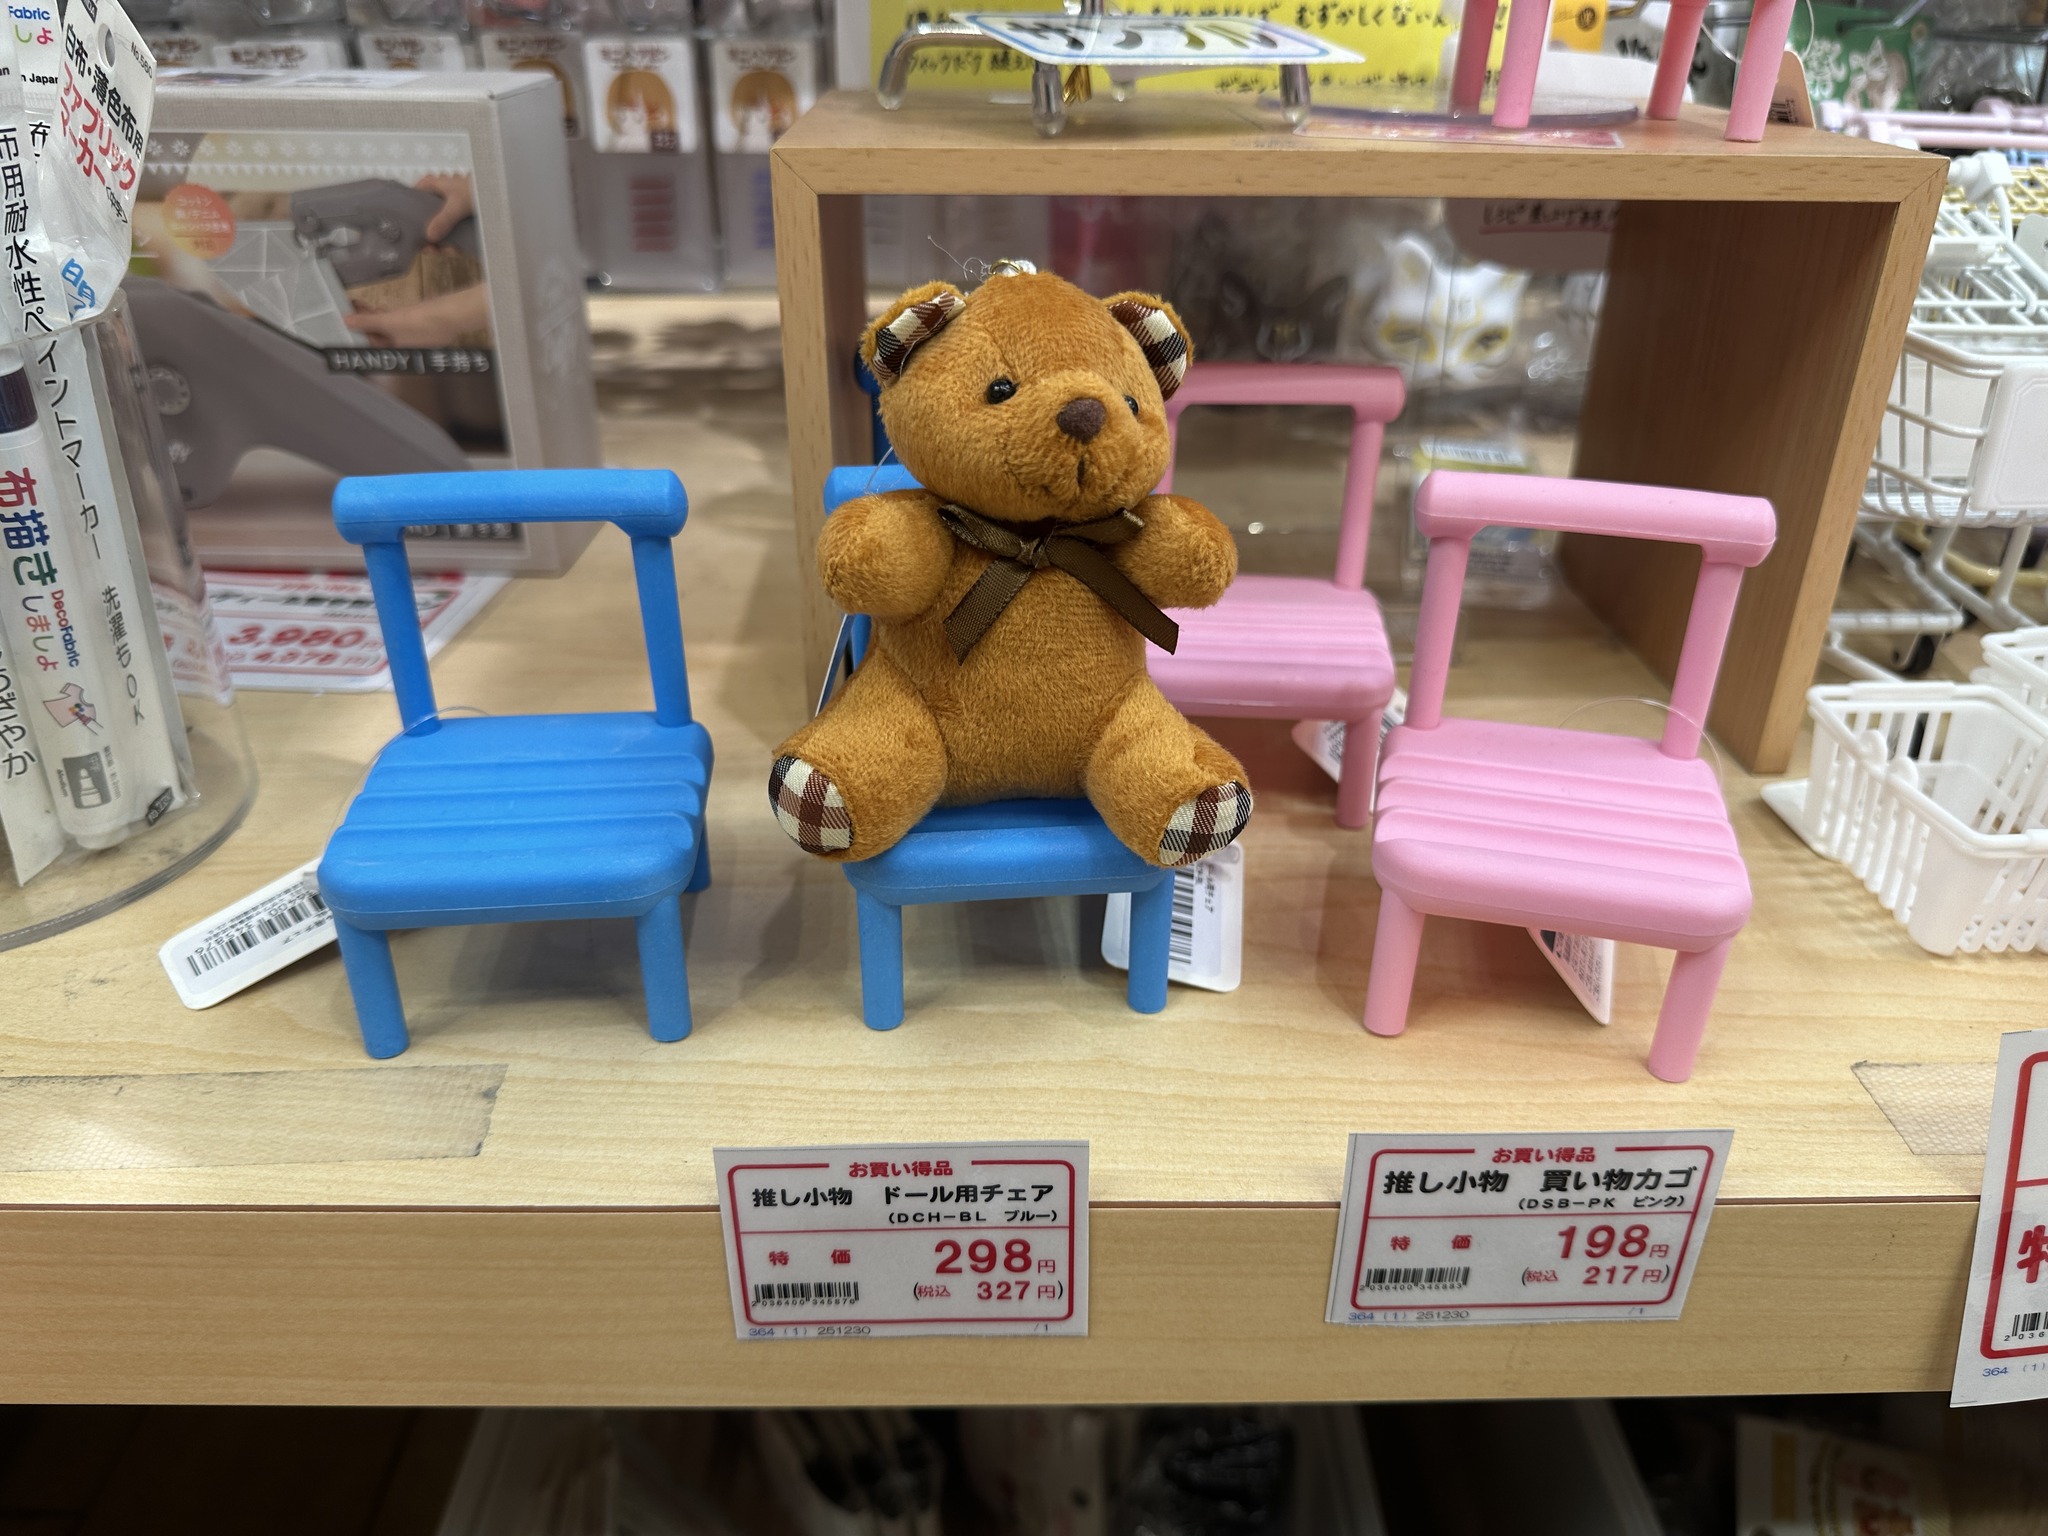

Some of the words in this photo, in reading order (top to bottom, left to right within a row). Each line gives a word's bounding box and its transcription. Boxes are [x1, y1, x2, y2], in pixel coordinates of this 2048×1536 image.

[66, 23, 144, 160] 白布・薄色布用
[335, 350, 410, 371] HANDY
[51, 589, 80, 668] DecoFabric
[1491, 1147, 1596, 1164] お買い得品
[849, 1161, 954, 1179] お買い得品
[1383, 1169, 1510, 1195] 推し小物
[1539, 1166, 1698, 1193] 買い物カゴ
[752, 1186, 852, 1207] 推し小物
[884, 1184, 1055, 1203] ドール用チェア
[1348, 1311, 1375, 1321] 364
[1416, 1310, 1470, 1320] 251230
[748, 1327, 776, 1337] 364
[817, 1326, 872, 1336] 251230
[1982, 1366, 2009, 1378] 364
